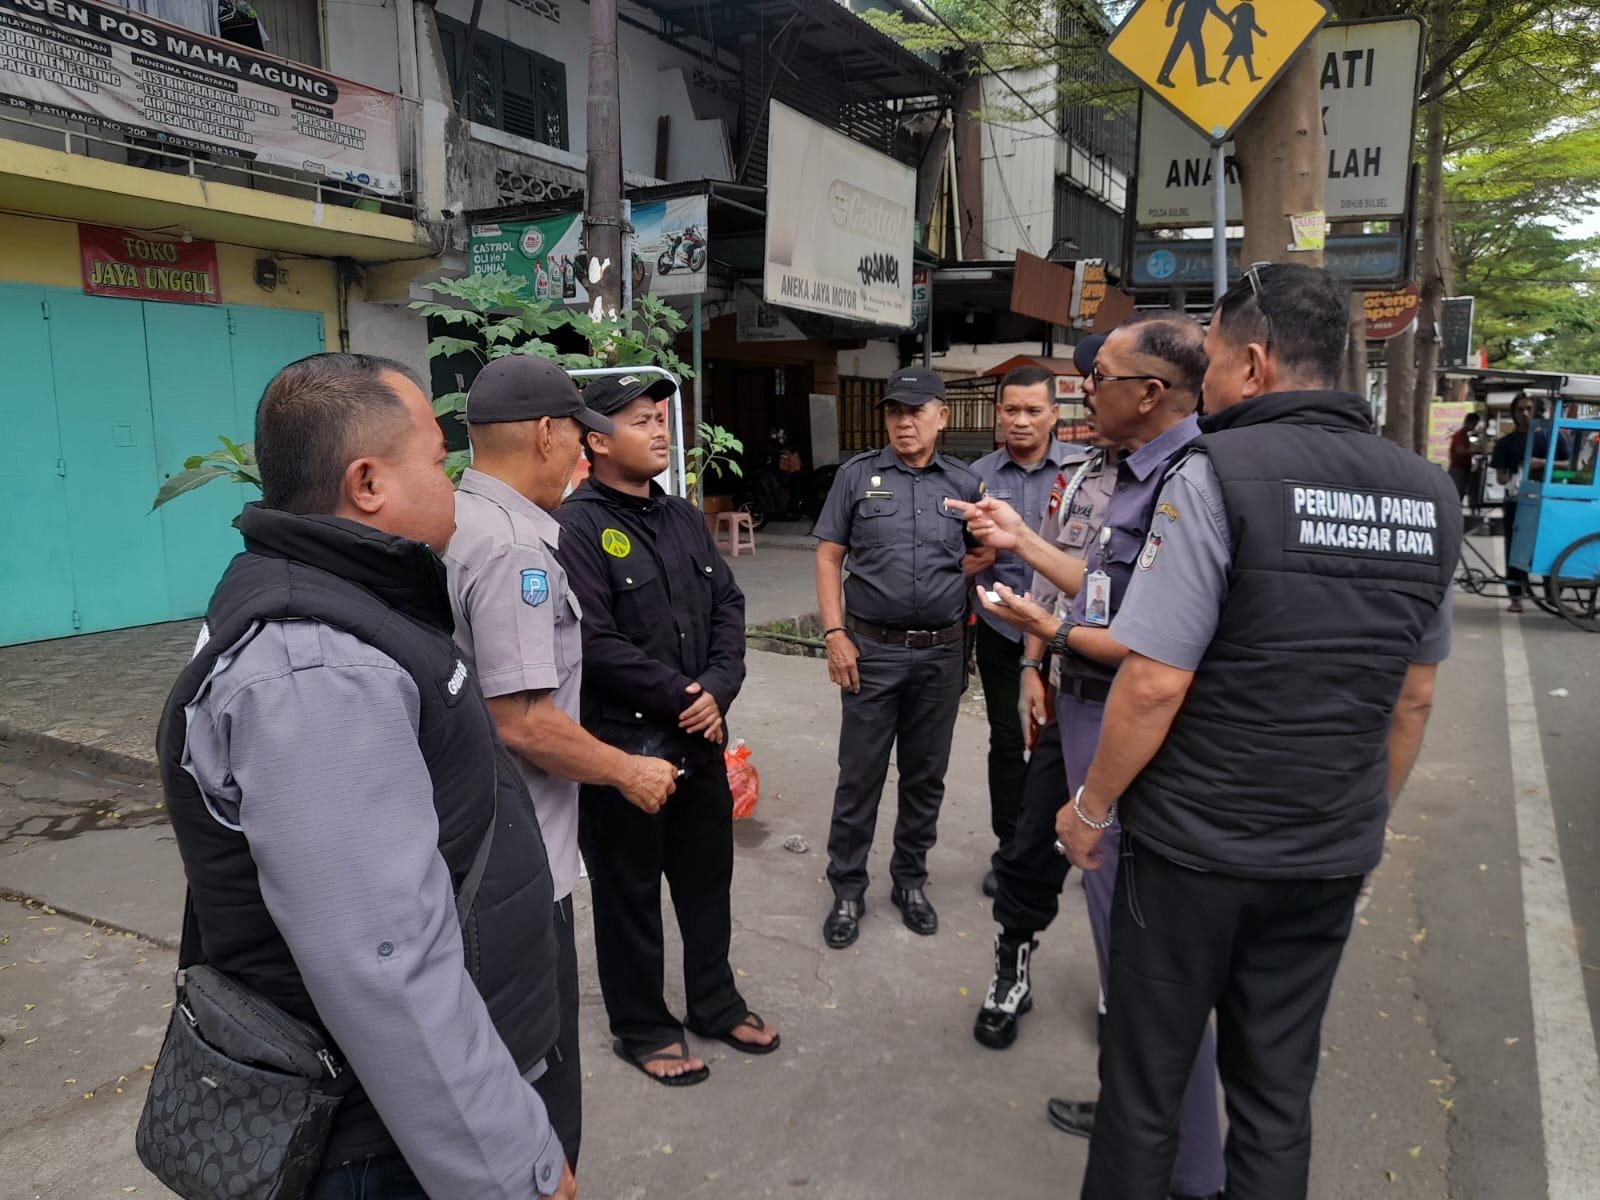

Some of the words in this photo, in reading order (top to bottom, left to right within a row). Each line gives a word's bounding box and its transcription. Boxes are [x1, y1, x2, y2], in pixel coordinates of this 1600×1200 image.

[0, 15, 42, 34] ELAYANI
[0, 27, 41, 50] SURAT
[43, 39, 111, 71] MENYURAT
[0, 42, 65, 72] DOKUMEN
[67, 61, 121, 87] PENTING
[14, 0, 89, 26] GEN
[100, 14, 158, 47] POS
[167, 36, 242, 73] MAHA
[250, 63, 329, 98] AGUNG
[0, 57, 41, 79] PAKET
[43, 67, 98, 93] BARANG
[136, 57, 181, 76] MENERIMA
[1320, 48, 1375, 90] ATI
[141, 69, 187, 92] LISTRIK
[186, 79, 241, 106] PRABAYAR
[143, 83, 188, 105] LISTRIK
[187, 92, 225, 114] PASCA
[144, 97, 165, 112] AIR
[165, 100, 207, 122] MINUM
[145, 108, 181, 127] PULSA
[201, 120, 253, 144] OPERATOR
[127, 126, 148, 137] 200
[1327, 146, 1382, 180] LAH
[123, 238, 178, 262] TOKO
[473, 241, 514, 254] CASTROL
[474, 255, 489, 264] OLI
[90, 262, 140, 288] JAYA
[144, 267, 215, 294] UNGGUL
[781, 274, 810, 300] ANEKA
[811, 281, 831, 305] JAYA
[831, 286, 858, 311] MOTOR
[1293, 487, 1377, 523] PERUMDA
[1380, 496, 1437, 529] PARKIR
[1299, 520, 1391, 552] MAKASSAR
[1396, 529, 1435, 556] RAYA
[530, 578, 541, 596] P
